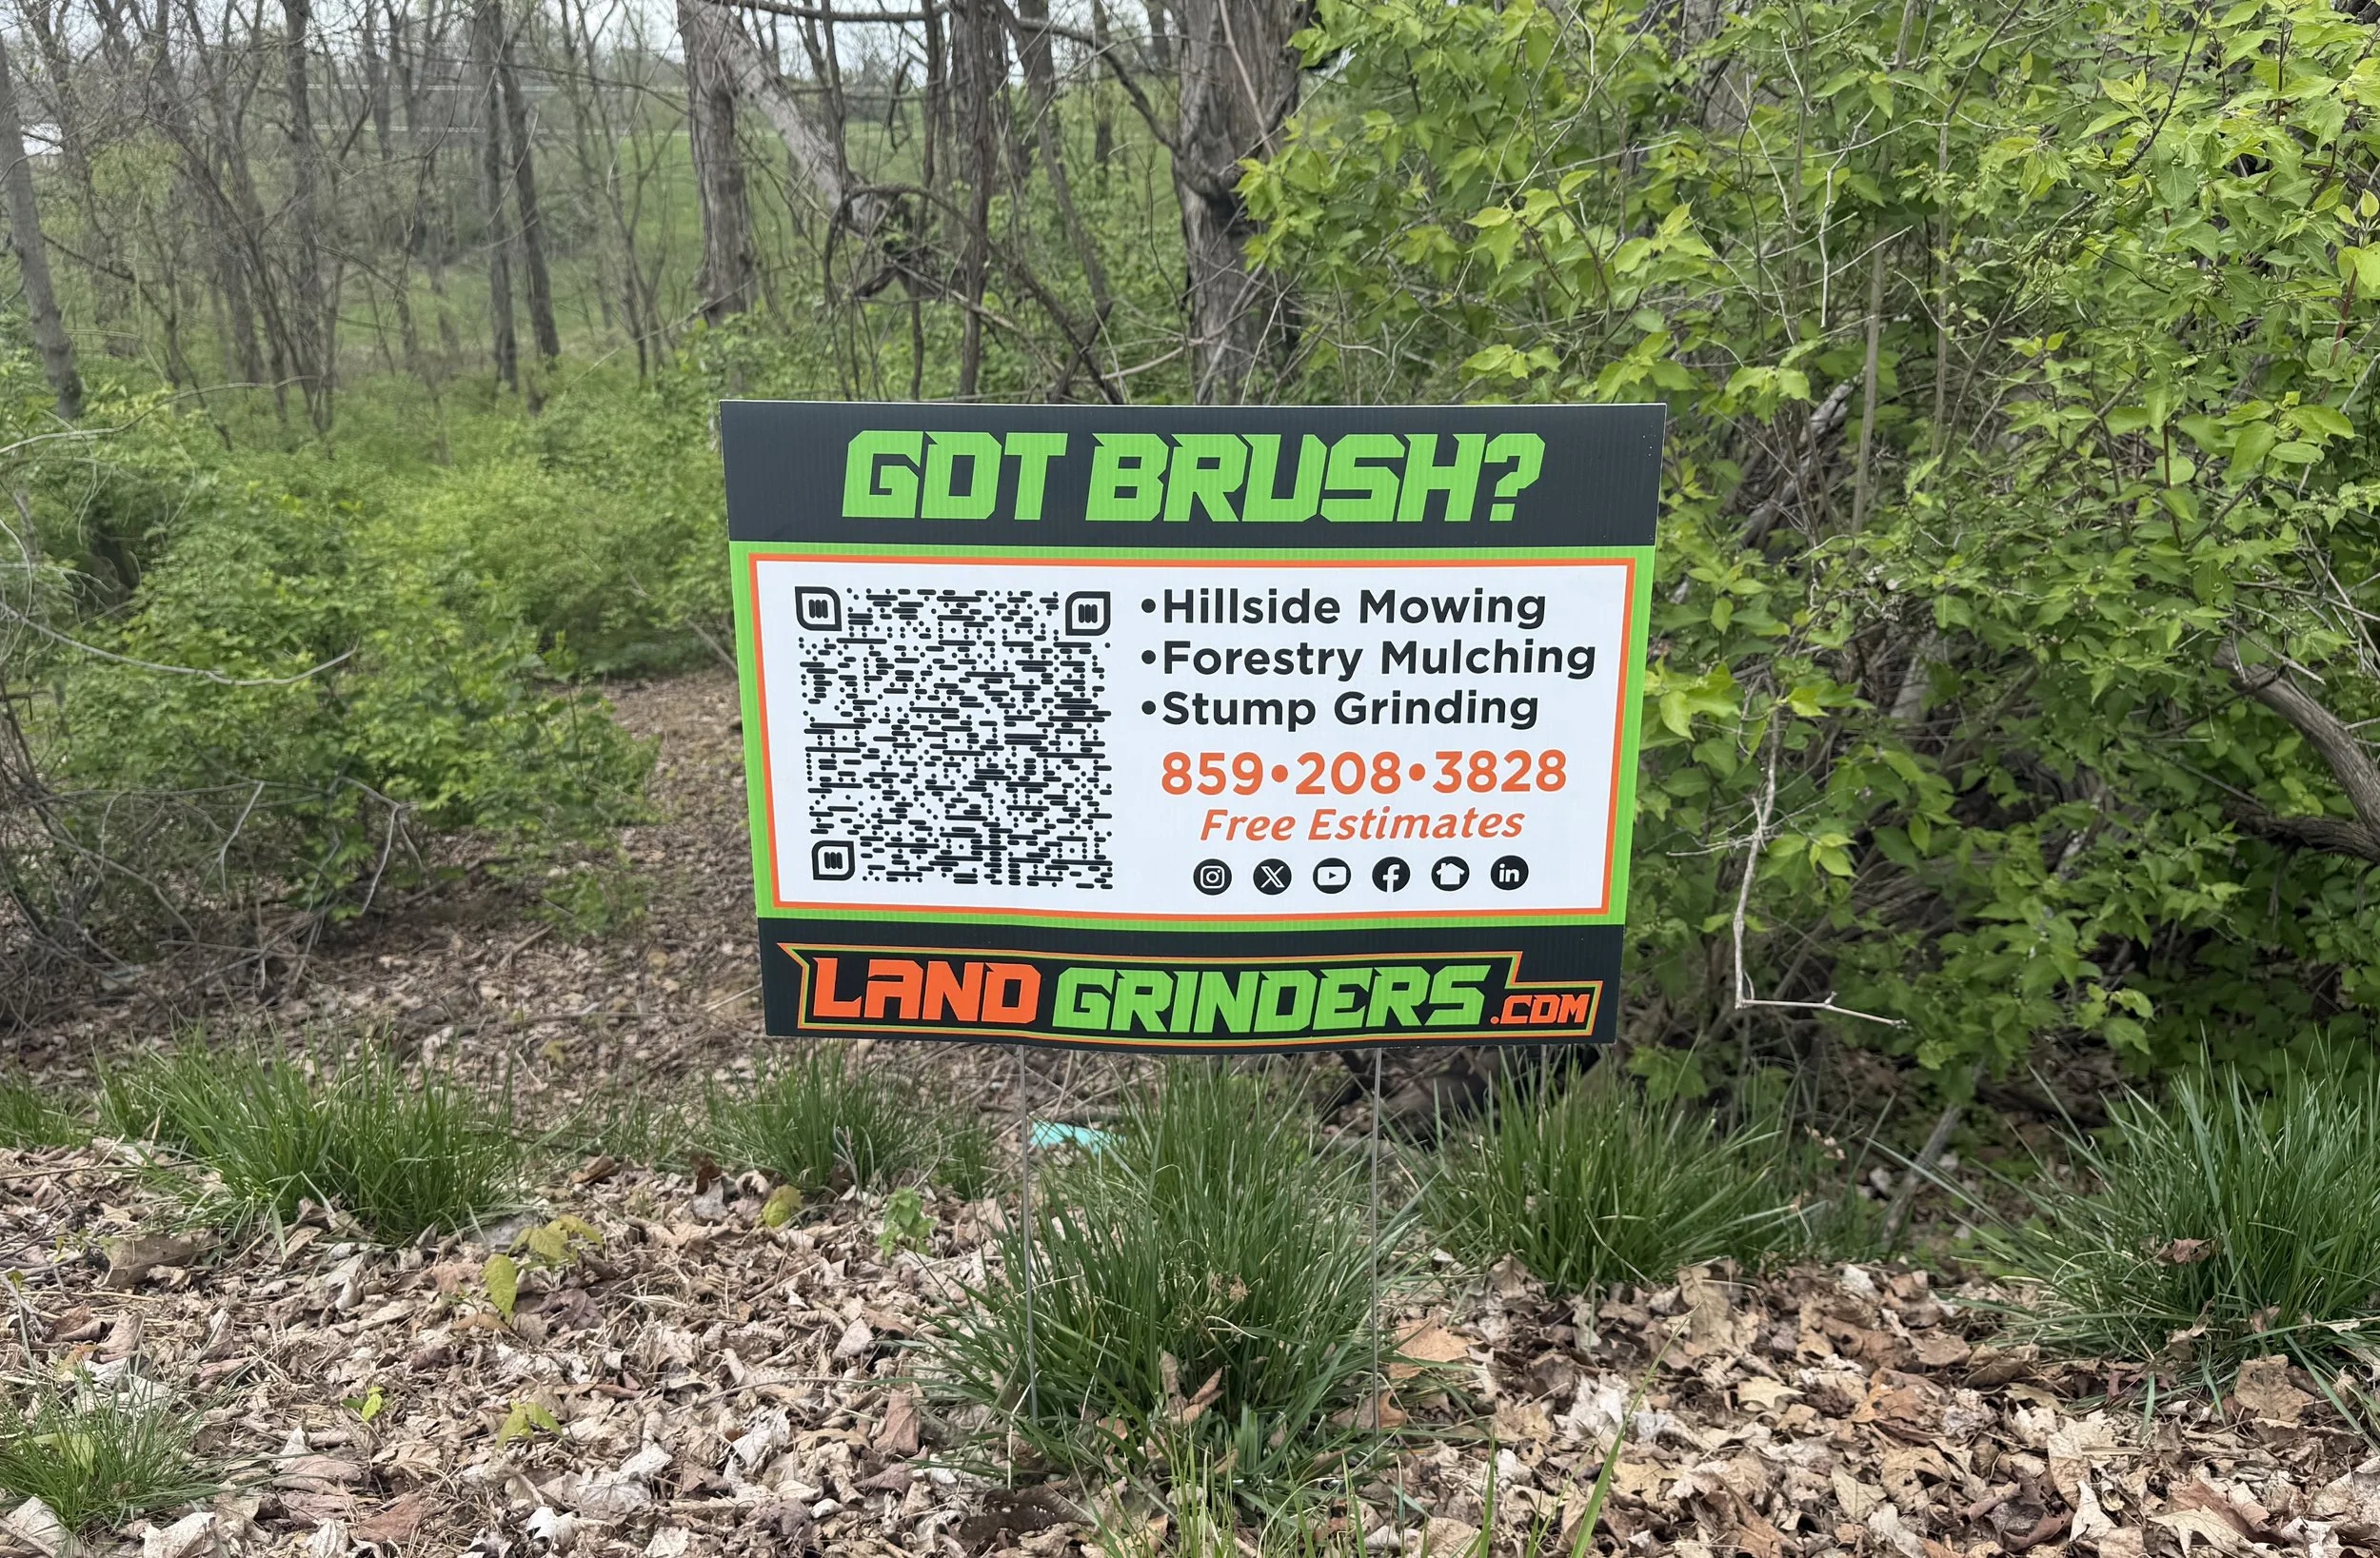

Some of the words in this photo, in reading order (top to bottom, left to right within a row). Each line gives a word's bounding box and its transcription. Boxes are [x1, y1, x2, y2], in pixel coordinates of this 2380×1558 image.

[843, 431, 1066, 519] GOT
[1087, 434, 1543, 522] BRUSH?
[1359, 587, 1546, 630] Mowing
[1381, 638, 1596, 680] Mulching
[1334, 689, 1538, 731] Grinding
[1200, 809, 1296, 841] Free
[1308, 806, 1526, 840] Estimates
[812, 956, 1041, 1024] LAND
[1052, 966, 1489, 1034] GRINDERS
[1491, 994, 1591, 1026] .COM
